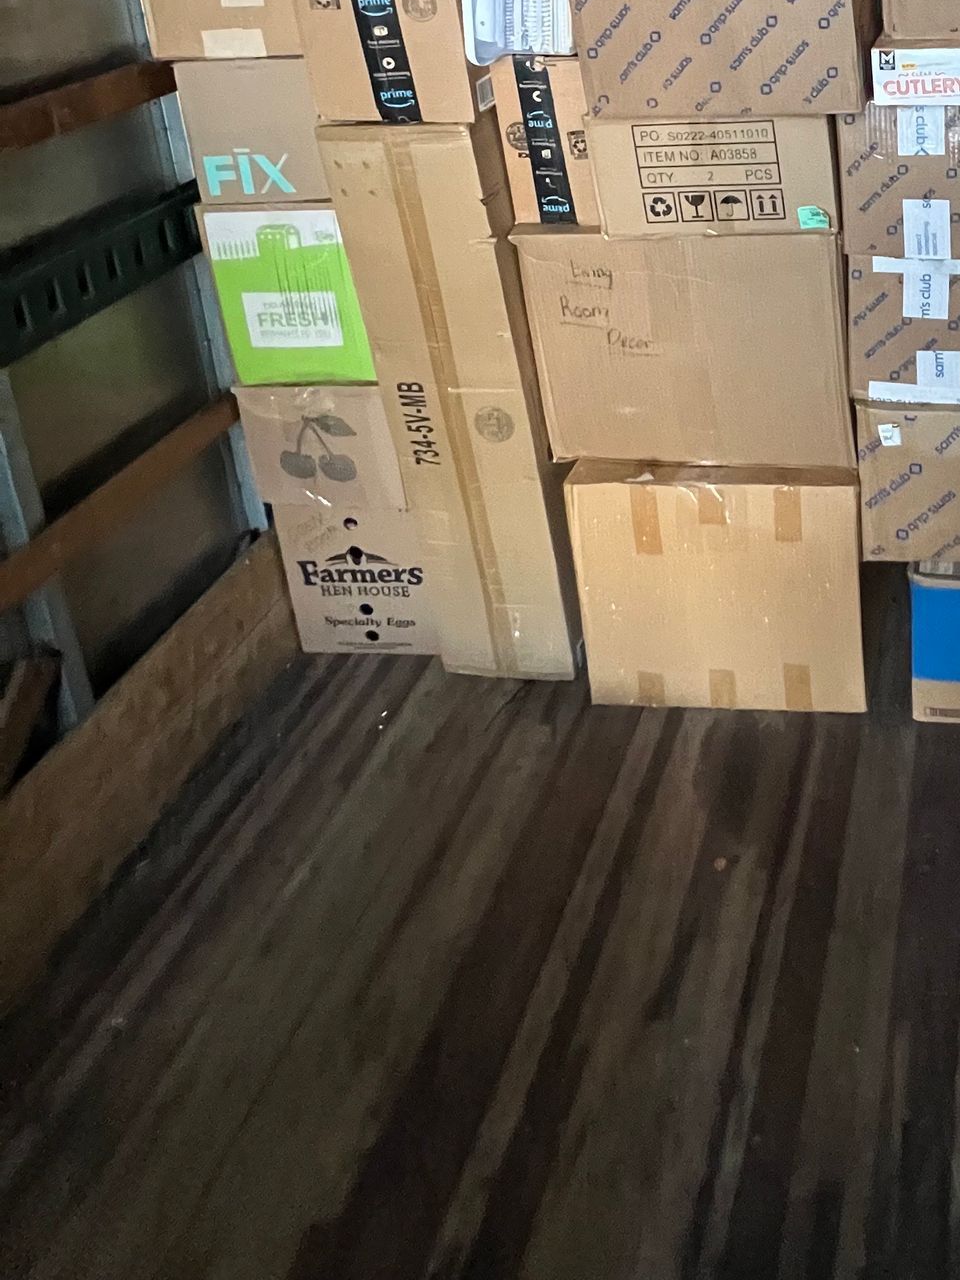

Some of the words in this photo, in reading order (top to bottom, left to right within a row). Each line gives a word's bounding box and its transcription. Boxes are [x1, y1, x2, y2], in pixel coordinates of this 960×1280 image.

[708, 13, 728, 34] club
[596, 28, 612, 48] club
[750, 26, 769, 48] club
[636, 42, 653, 62] club
[769, 64, 788, 85] club
[380, 87, 413, 101] prime
[810, 77, 830, 100] club
[916, 116, 928, 145] club
[642, 151, 676, 163] ITEM
[707, 170, 715, 181] 2
[745, 168, 773, 181] PCS
[880, 174, 900, 193] club
[919, 272, 932, 299] club
[257, 311, 330, 328] FRESH
[396, 380, 442, 467] 734-5V-MB
[890, 472, 910, 492] club
[907, 512, 930, 532] club
[296, 560, 424, 586] Farmers
[320, 585, 353, 597] HEN
[358, 586, 411, 598] HOUSE
[324, 616, 382, 628] Specialty
[387, 617, 416, 628] Eggs
